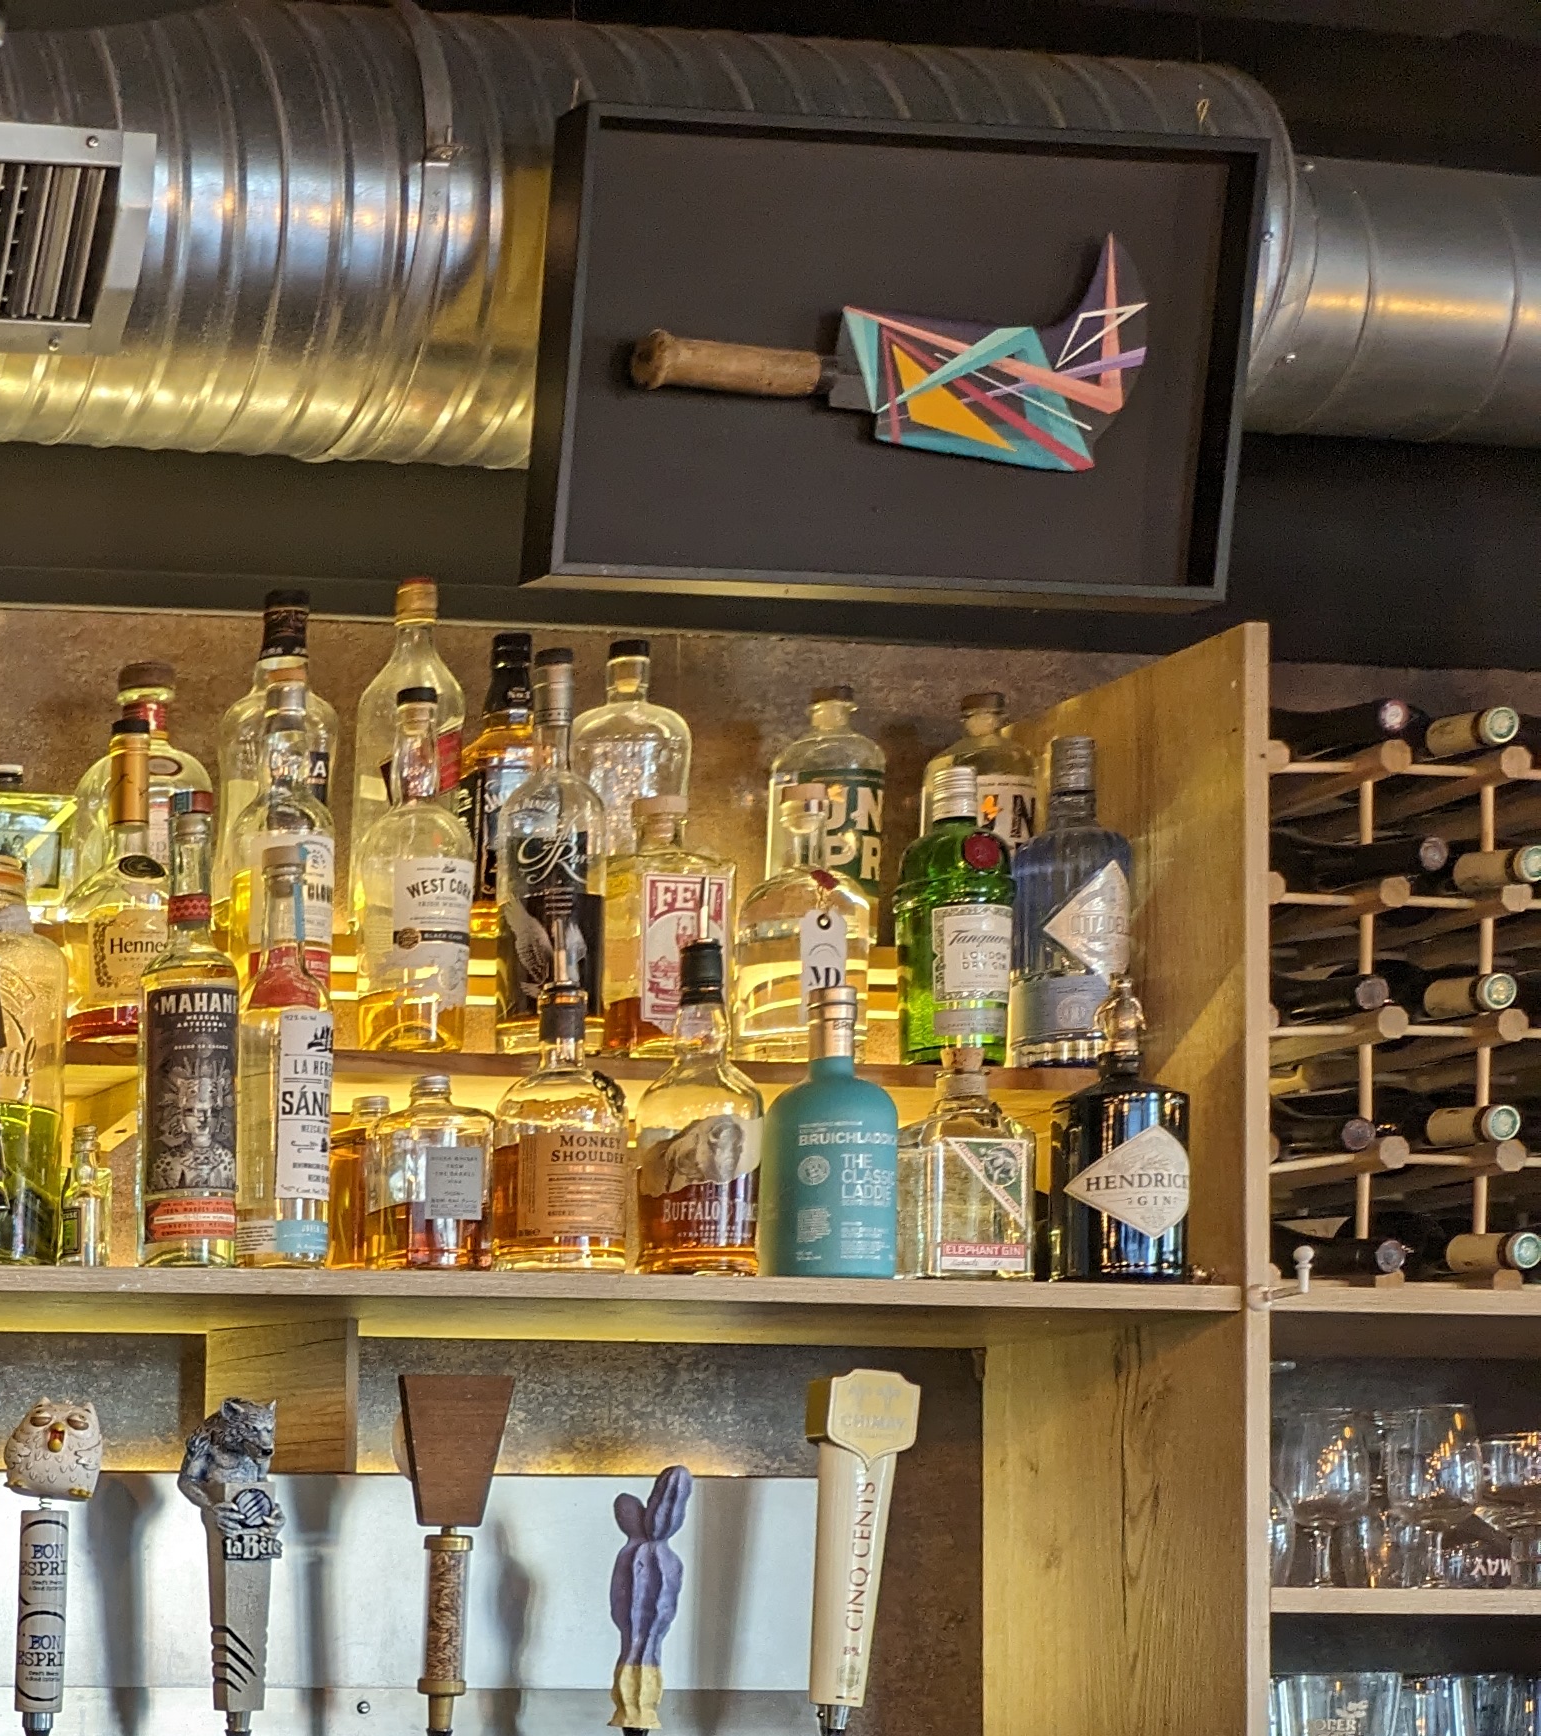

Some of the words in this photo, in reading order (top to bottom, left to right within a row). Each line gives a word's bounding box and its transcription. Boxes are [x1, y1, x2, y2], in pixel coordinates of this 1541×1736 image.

[407, 879, 446, 898] WEST
[949, 930, 1009, 949] Tanquer
[961, 961, 986, 971] DRY
[560, 1134, 622, 1148] MONKEY
[841, 1154, 872, 1170] THE
[841, 1184, 892, 1200] LADDIE
[1134, 1195, 1170, 1207] GIN
[944, 1243, 999, 1257] ELEPHANT
[1002, 1244, 1024, 1256] GIN
[852, 1481, 876, 1558] CENTS
[31, 1544, 63, 1560] BON
[226, 1540, 243, 1555] la
[244, 1535, 282, 1559] Bête
[21, 1562, 67, 1576] ESPRI
[845, 1571, 871, 1632] CINQ
[29, 1635, 61, 1650] BON
[18, 1652, 64, 1667] ESPRI
